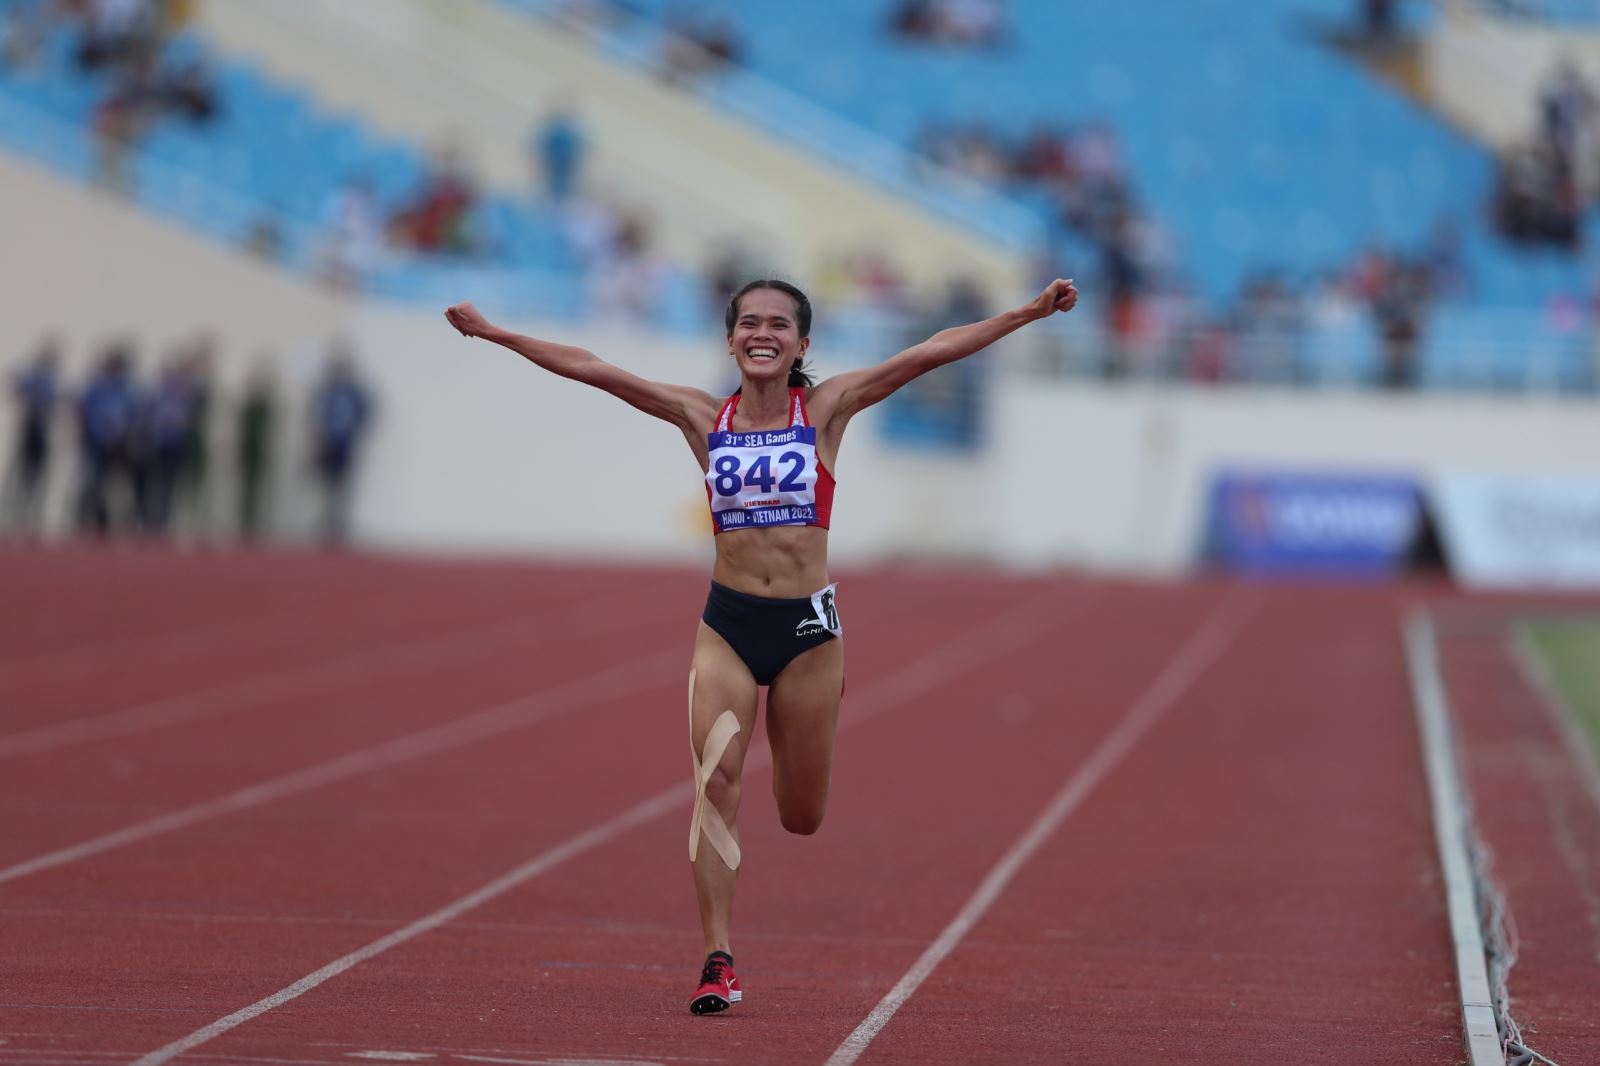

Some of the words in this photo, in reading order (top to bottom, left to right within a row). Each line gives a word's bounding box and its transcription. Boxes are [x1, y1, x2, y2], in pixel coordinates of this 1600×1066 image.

[744, 434, 764, 447] SEA
[765, 430, 797, 445] Games
[714, 451, 807, 497] 842
[743, 499, 781, 508] VIETNAM
[721, 511, 745, 525] HANOI
[752, 507, 790, 524] VIETNAM
[791, 506, 814, 519] 2022
